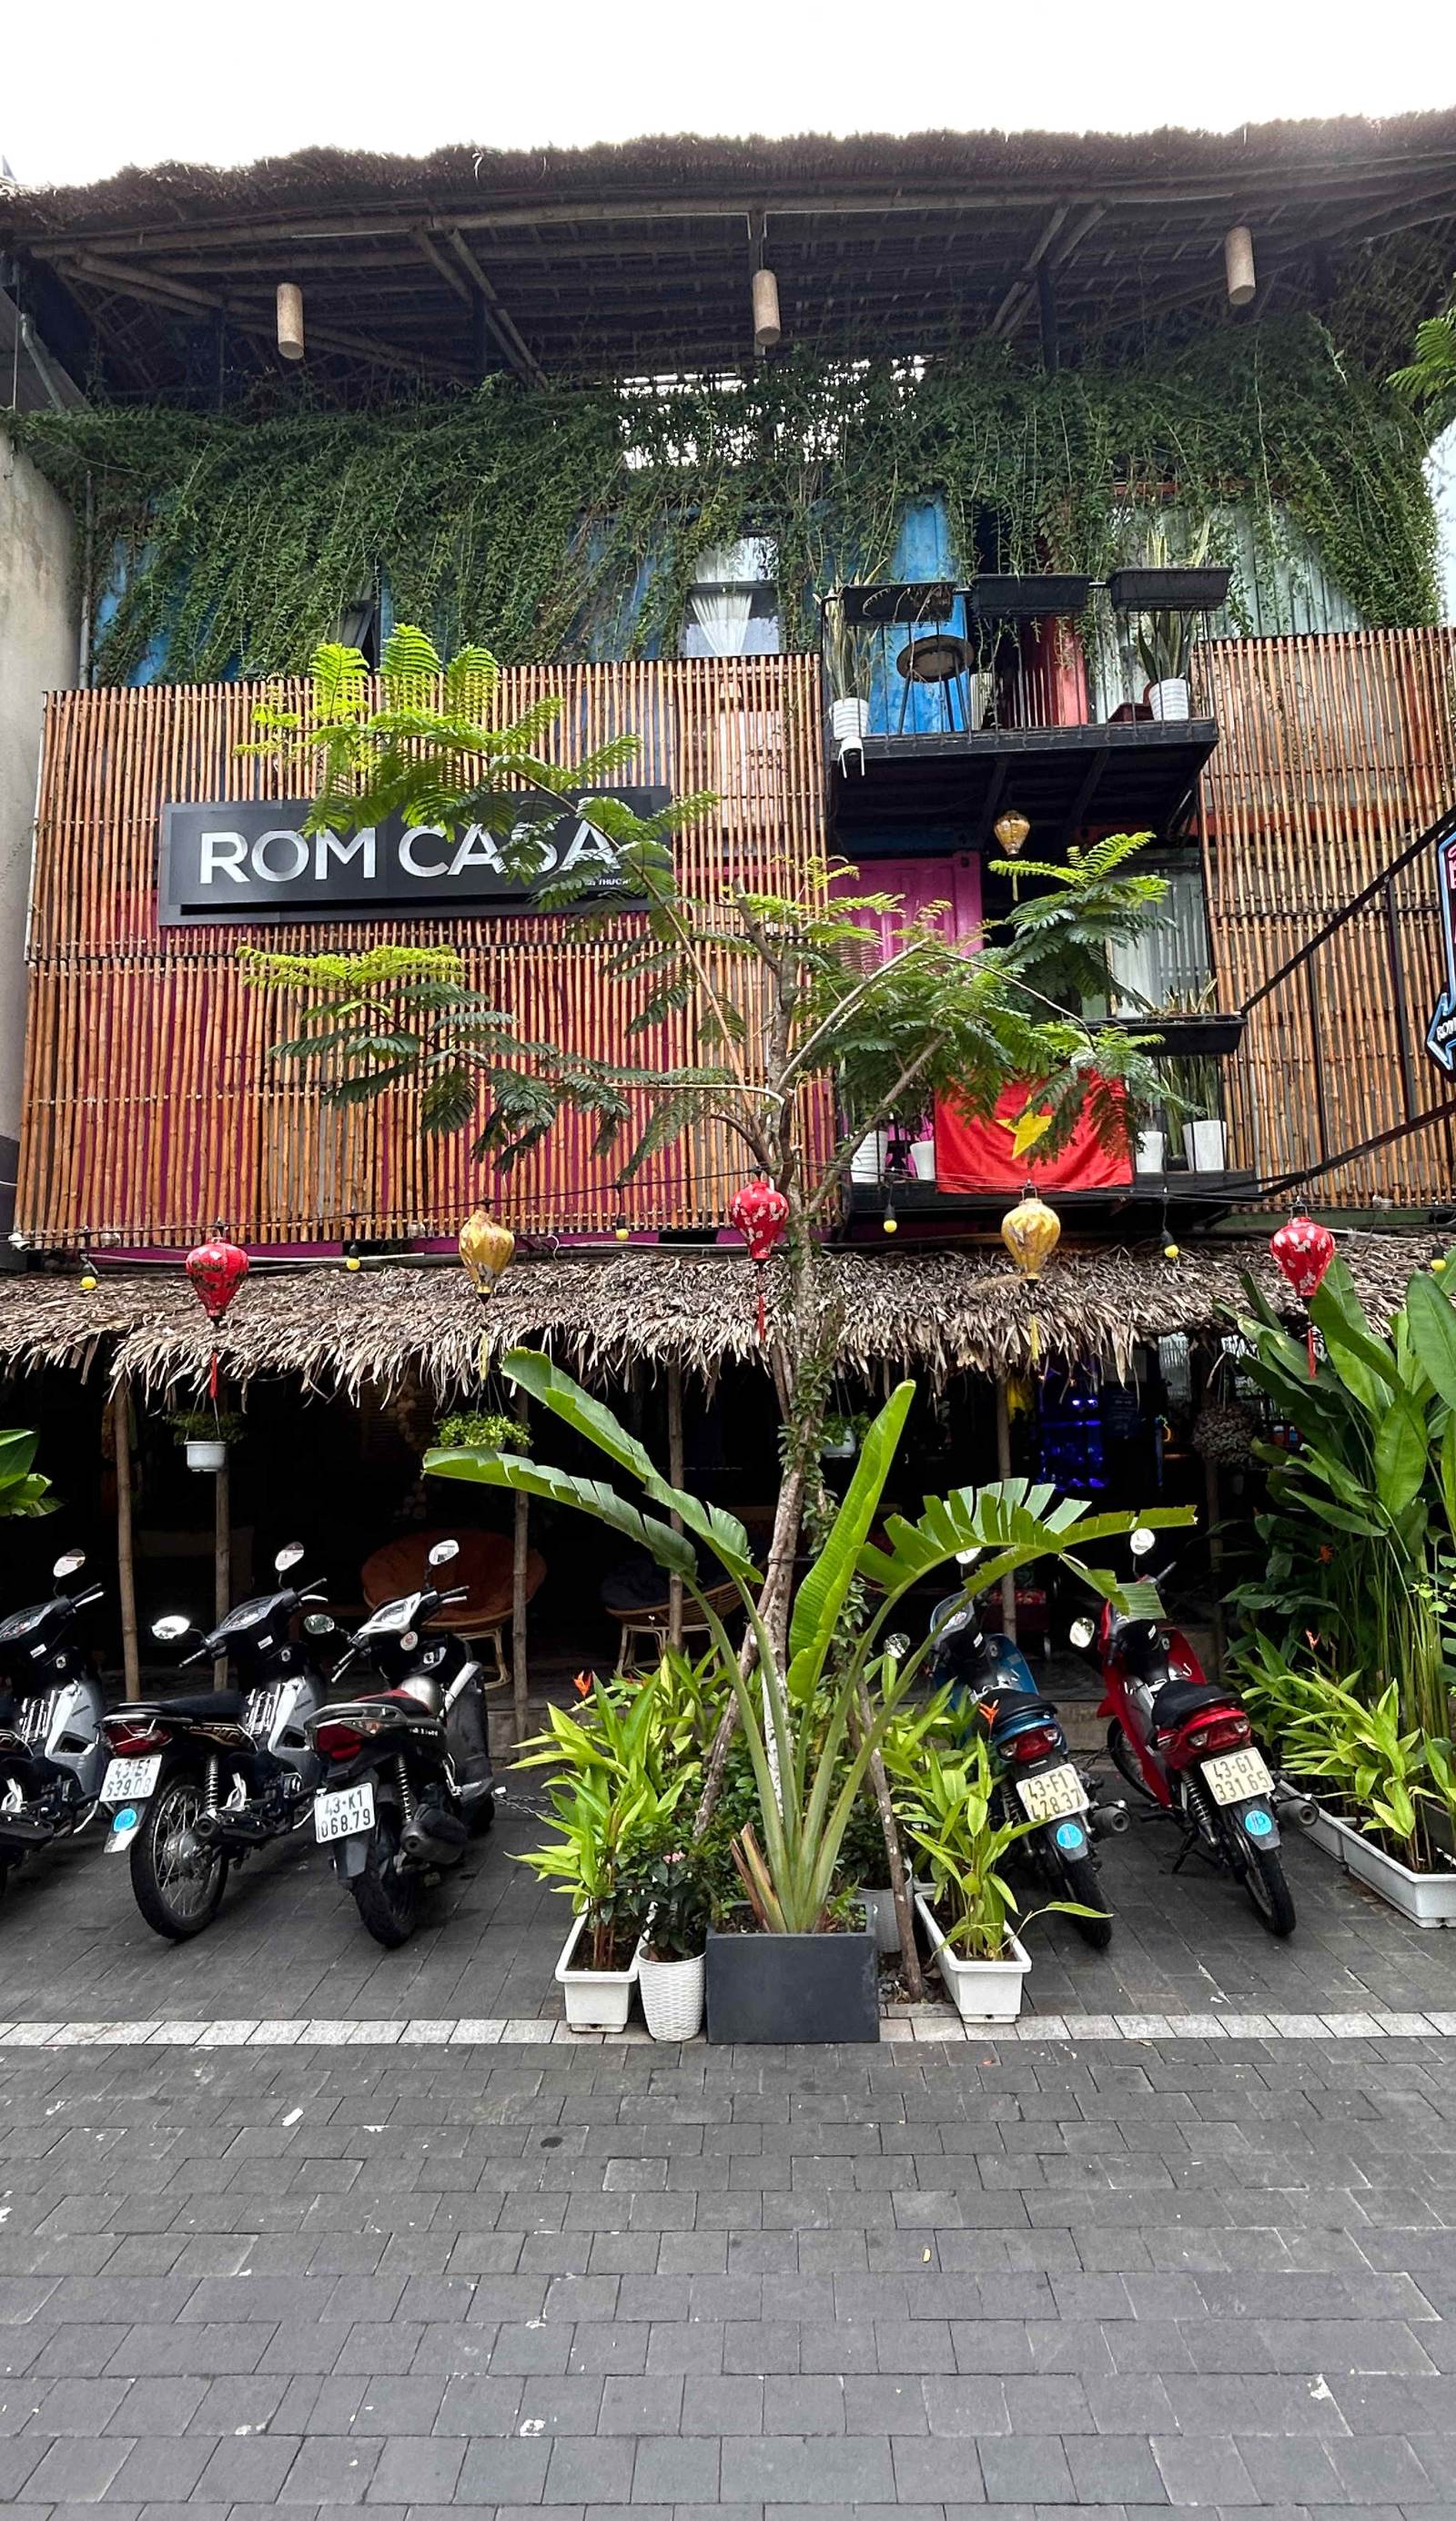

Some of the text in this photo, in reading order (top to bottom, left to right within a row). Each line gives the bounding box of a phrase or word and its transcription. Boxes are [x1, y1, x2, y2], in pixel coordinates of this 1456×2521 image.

[198, 826, 377, 884] ROM
[325, 1789, 363, 1816] 43-K1
[321, 1807, 371, 1838] 068.79
